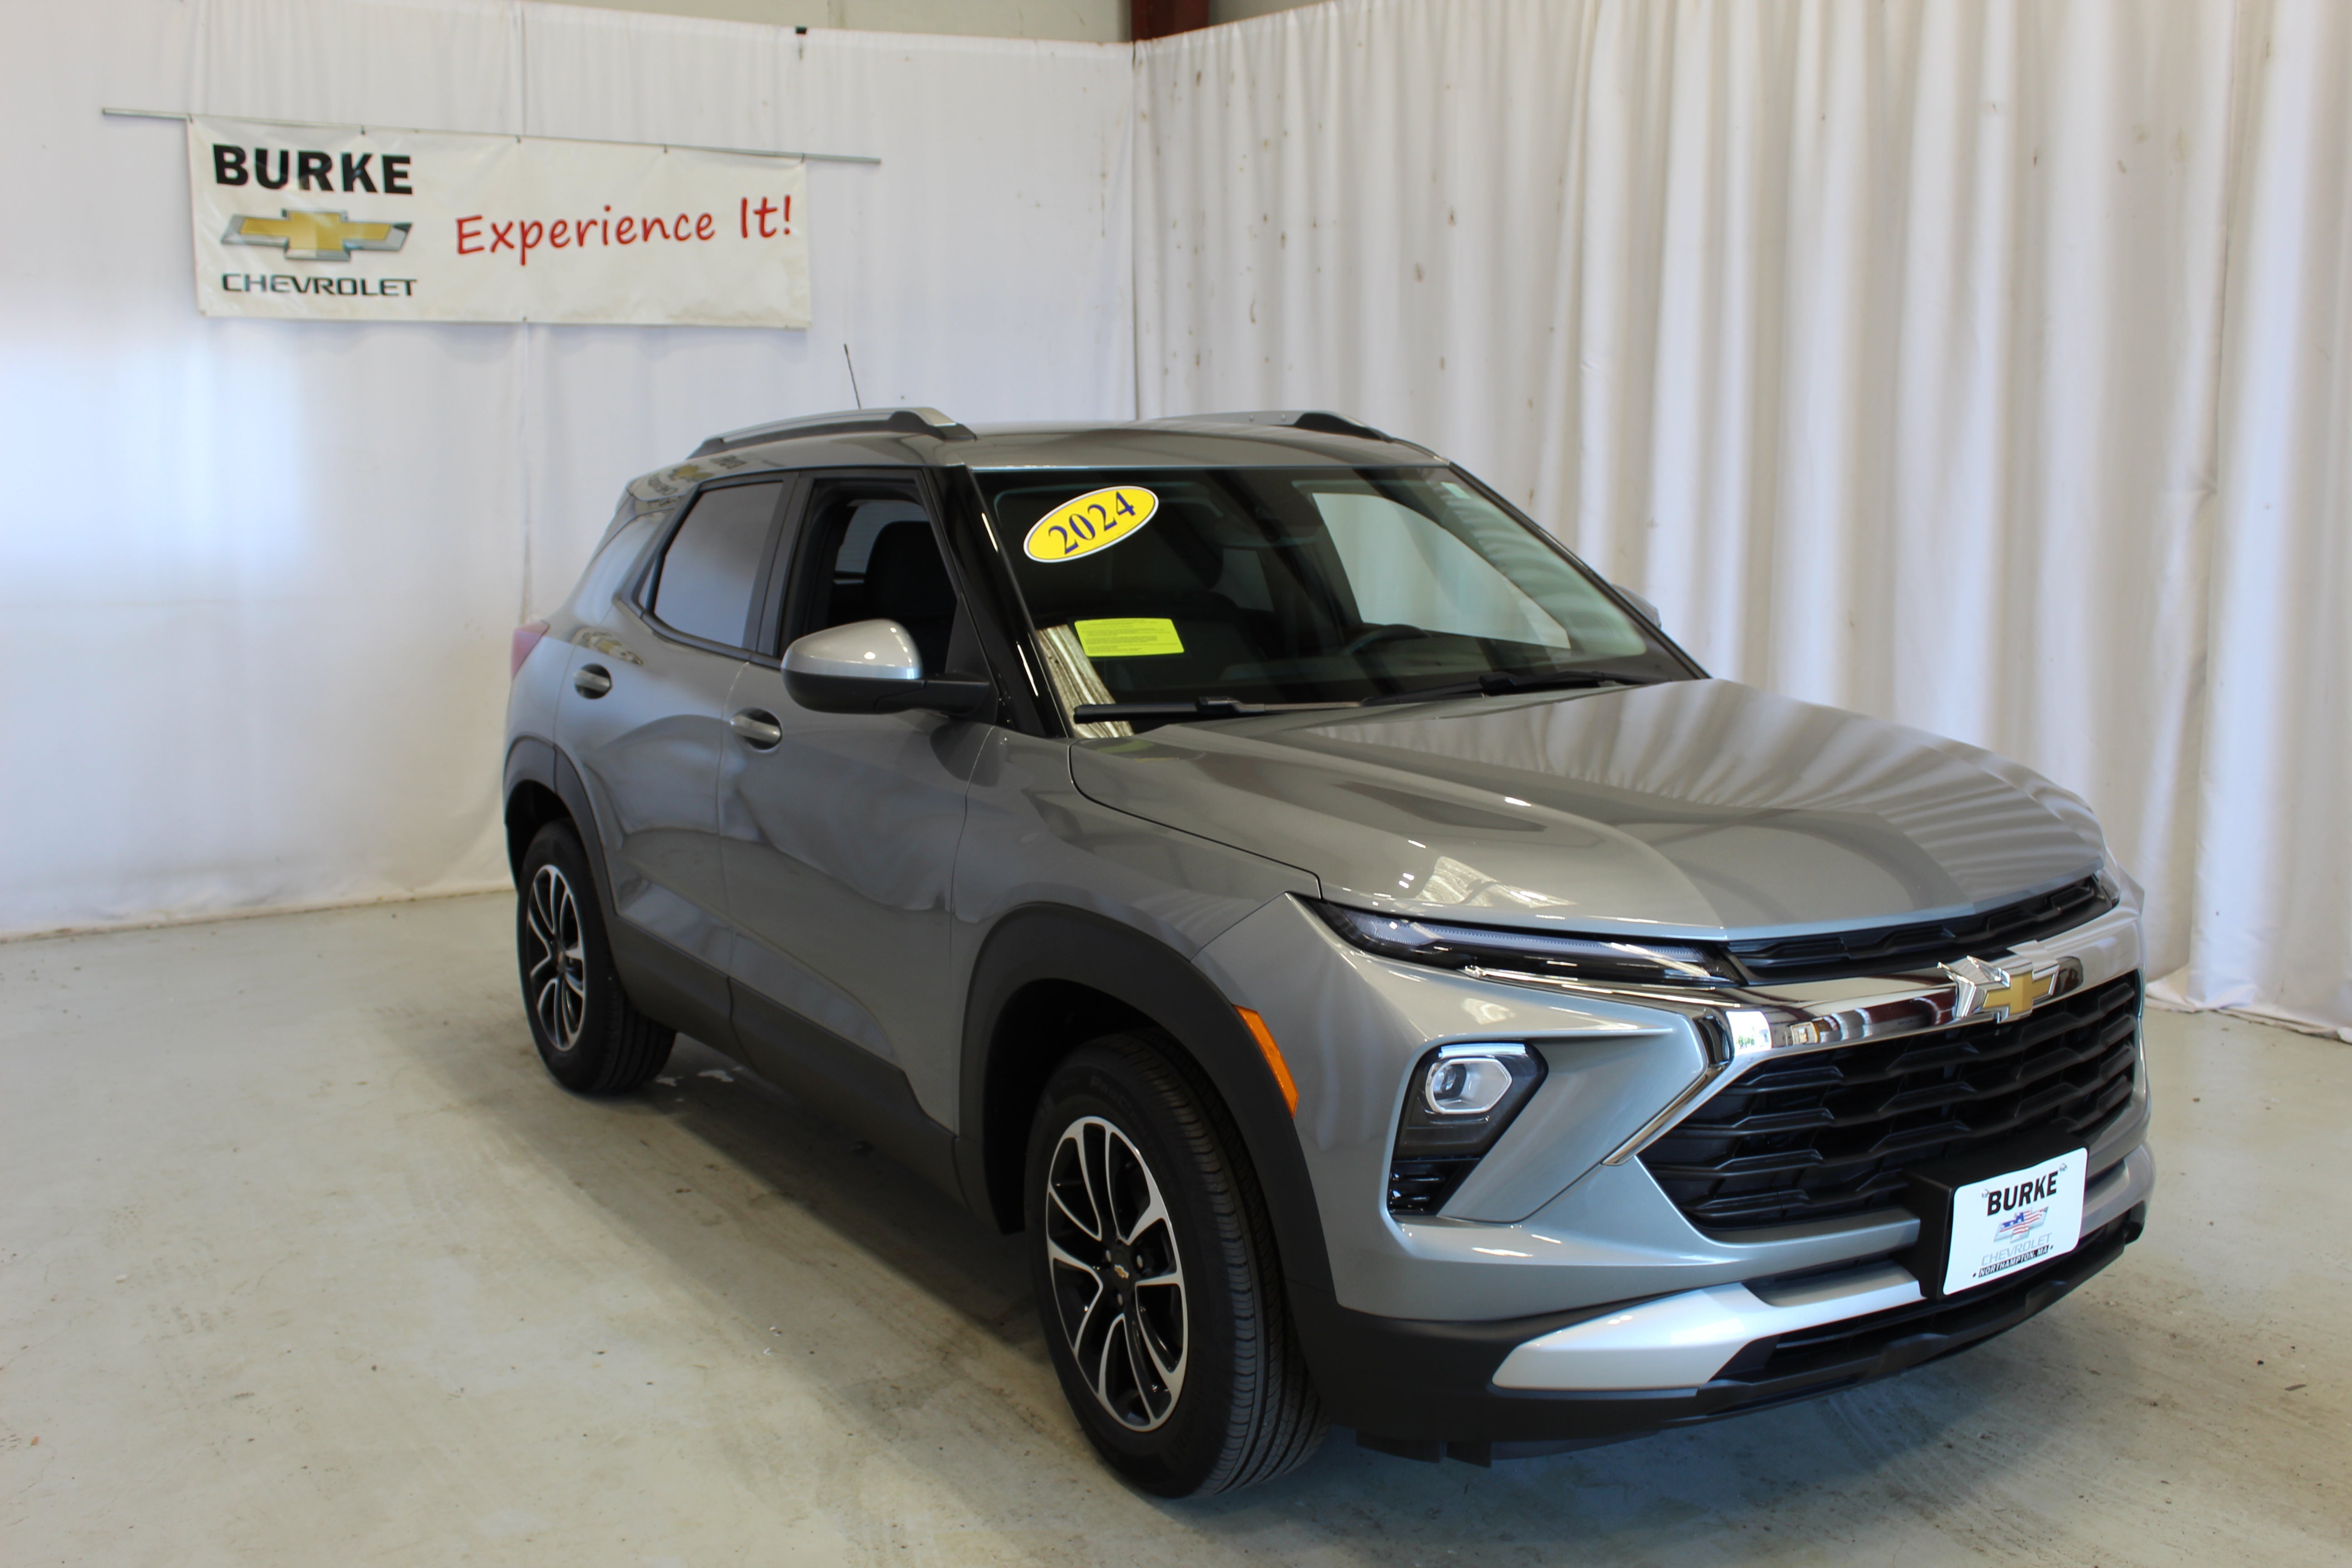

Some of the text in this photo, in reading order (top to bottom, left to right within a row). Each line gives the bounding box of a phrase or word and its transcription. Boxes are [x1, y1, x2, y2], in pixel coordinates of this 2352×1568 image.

[213, 144, 413, 195] BURKE
[456, 195, 792, 266] Experience It!
[222, 274, 417, 296] CHEVROLET
[1048, 491, 1136, 554] 2024
[1987, 1171, 2058, 1216] BURKE
[1981, 1232, 2052, 1266] CHEVROLET
[2036, 1245, 2049, 1255] MA
